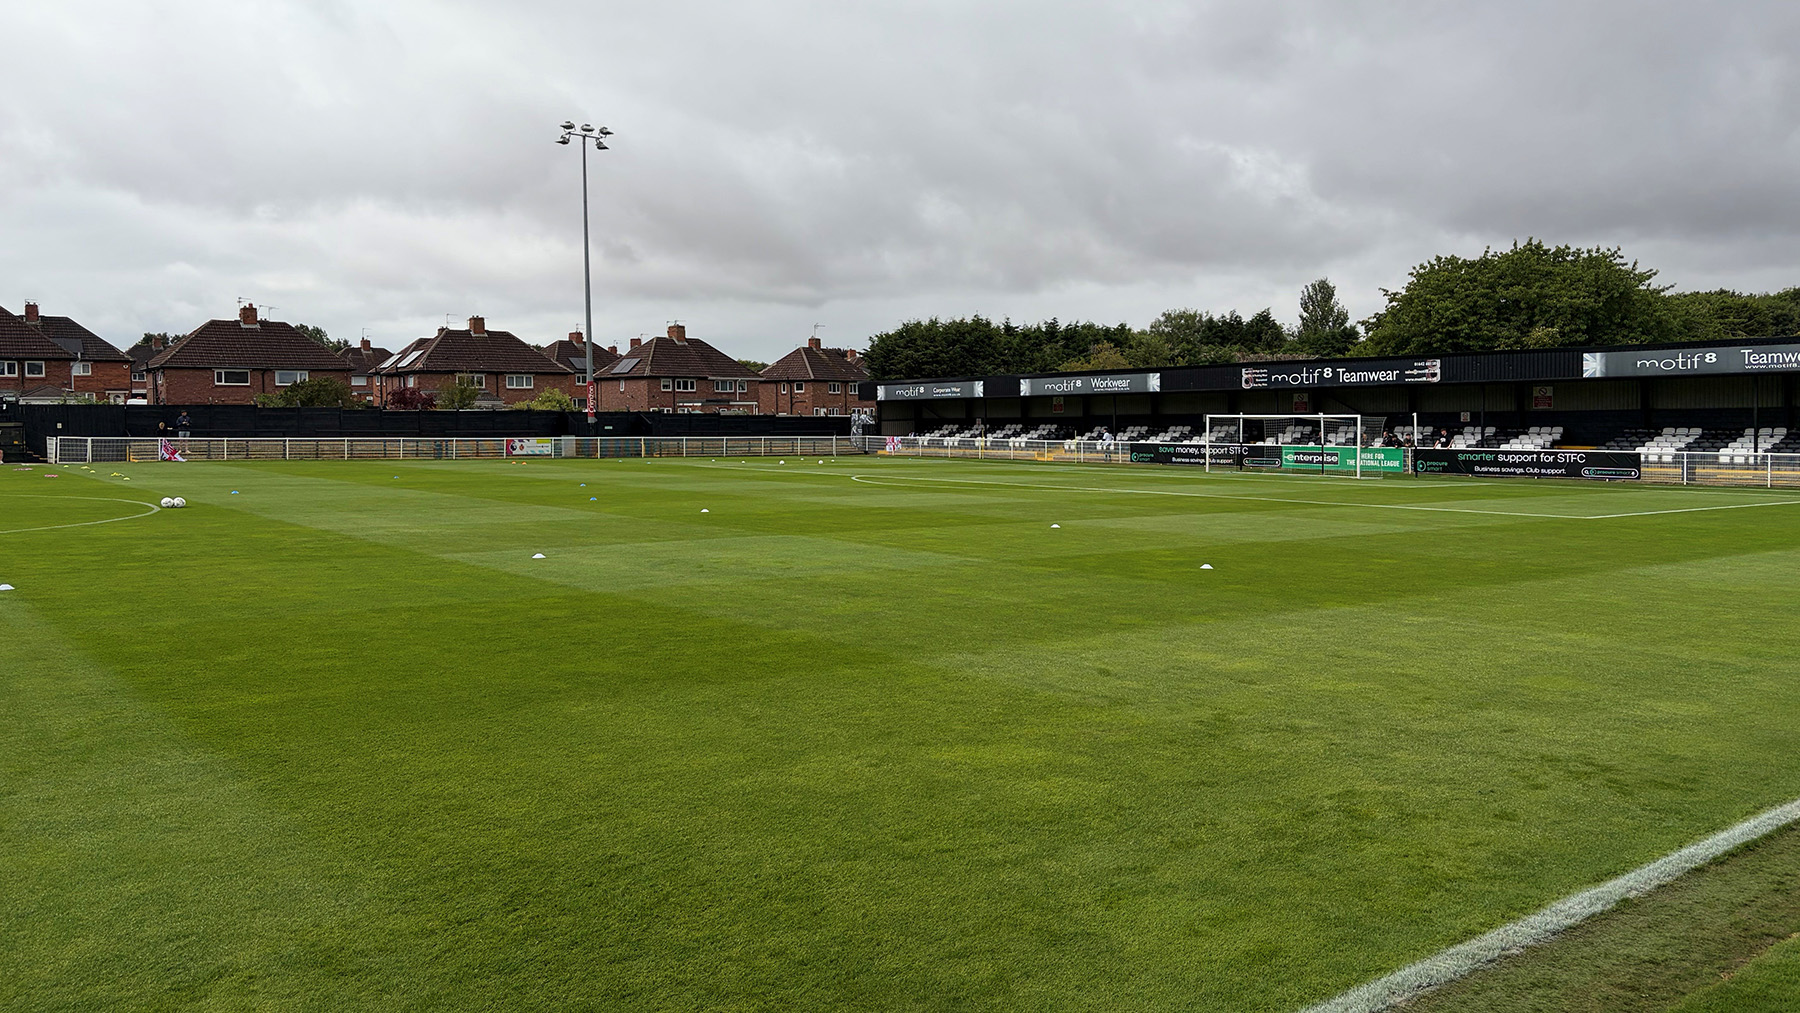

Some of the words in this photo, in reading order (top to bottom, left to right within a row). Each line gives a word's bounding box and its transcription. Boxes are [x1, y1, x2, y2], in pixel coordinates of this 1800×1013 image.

[1636, 351, 1718, 371] motif8
[1271, 366, 1333, 385] motif8
[1336, 368, 1400, 383] Teamwear
[1044, 378, 1083, 392] motif8
[1090, 377, 1131, 388] Workwear
[895, 386, 925, 398] motif8
[1284, 453, 1338, 463] enterprise
[1359, 459, 1380, 467] ATIONAL
[1457, 452, 1495, 461] smarter
[1497, 453, 1537, 464] support
[1540, 452, 1555, 463] for
[1557, 452, 1586, 464] STFC
[1474, 465, 1500, 473] Business
[1540, 467, 1567, 475] support.
